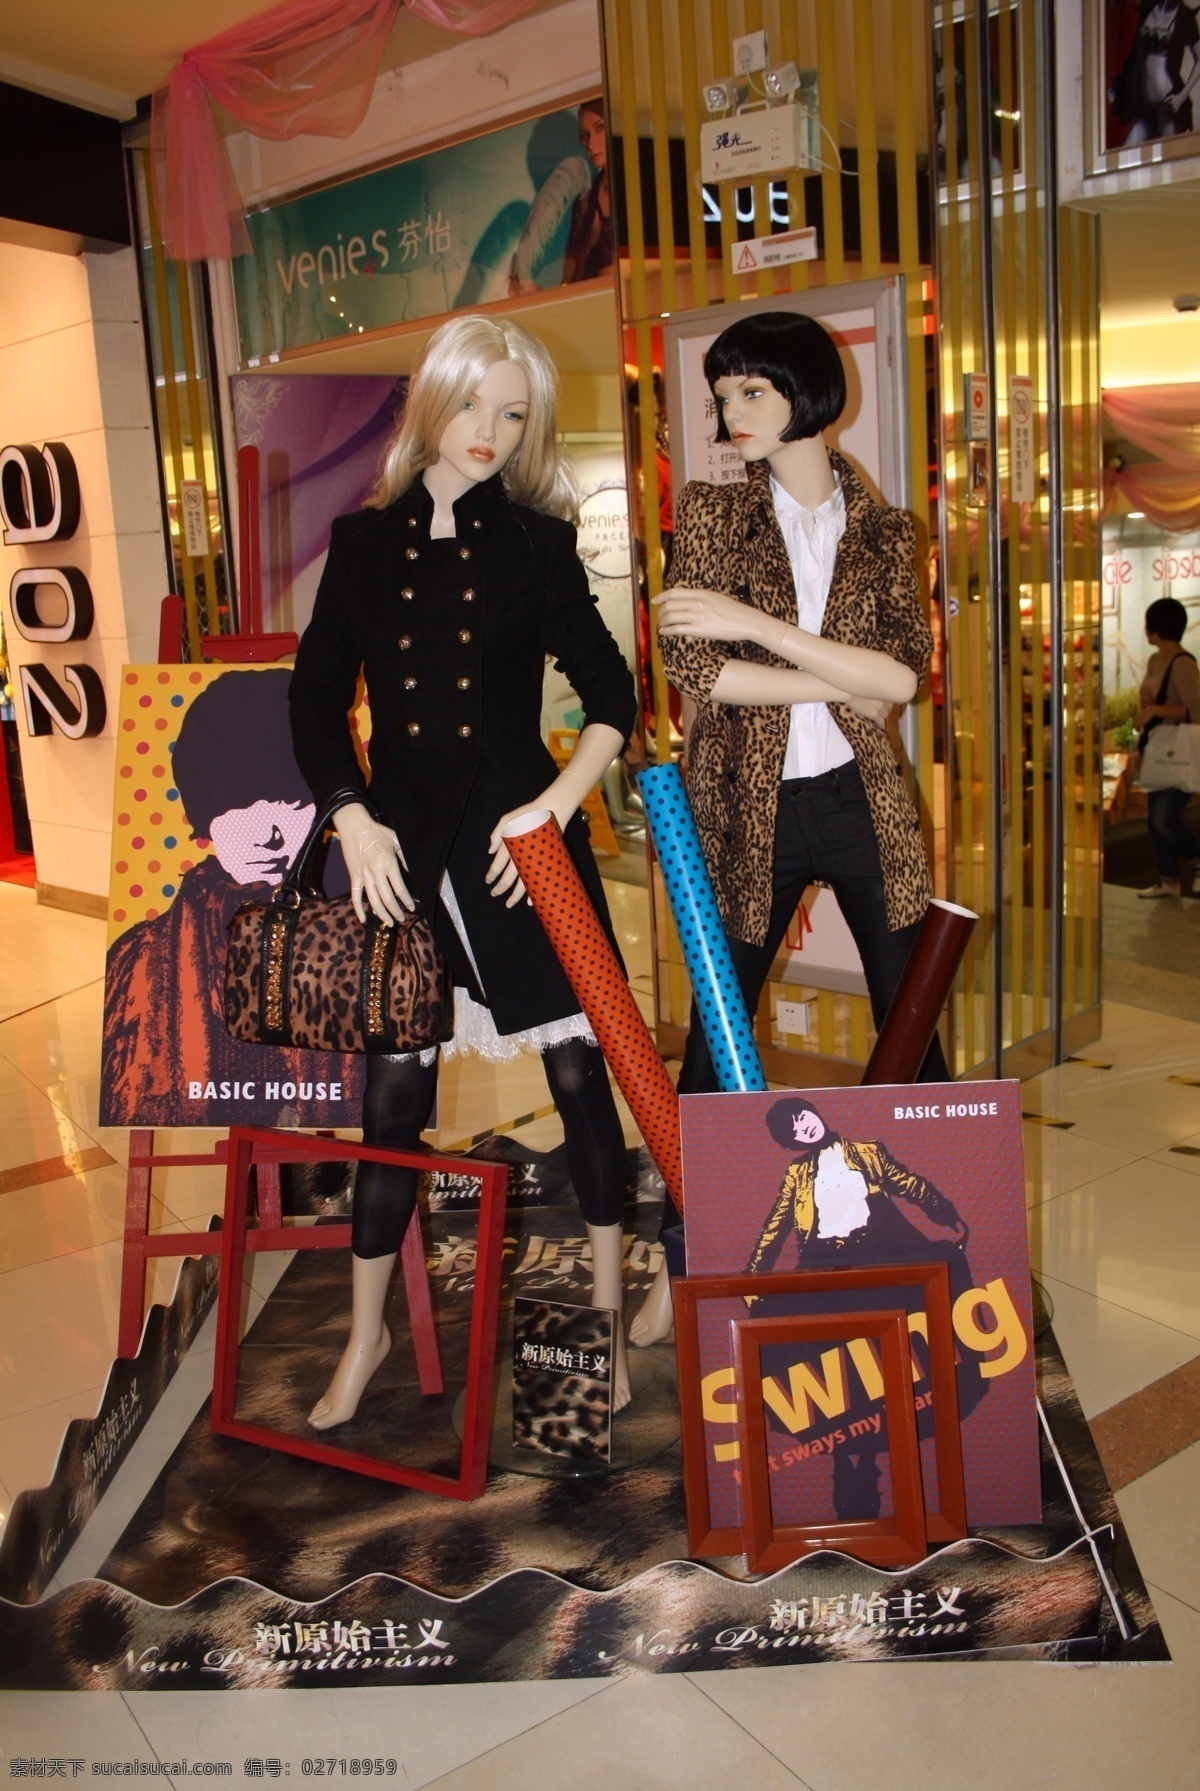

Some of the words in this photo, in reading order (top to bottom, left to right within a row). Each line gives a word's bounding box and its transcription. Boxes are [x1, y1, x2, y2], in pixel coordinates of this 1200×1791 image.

[397, 211, 451, 262] 芬怡
[188, 1082, 255, 1100] BASIC
[265, 1082, 342, 1100] HOUSE
[894, 1106, 940, 1119] BASIC
[946, 1103, 998, 1117] HOUSE
[521, 1342, 607, 1373] 新原始主义
[82, 1378, 140, 1482] 新原始主义
[782, 1429, 846, 1466] sways
[848, 1412, 881, 1439] my
[770, 1587, 966, 1630] 新原始主义
[252, 1618, 451, 1654] 新原始主义
[599, 1629, 701, 1660] New
[711, 1620, 970, 1651] Primitivism
[93, 1647, 191, 1673] New
[200, 1648, 459, 1672] Primitivism
